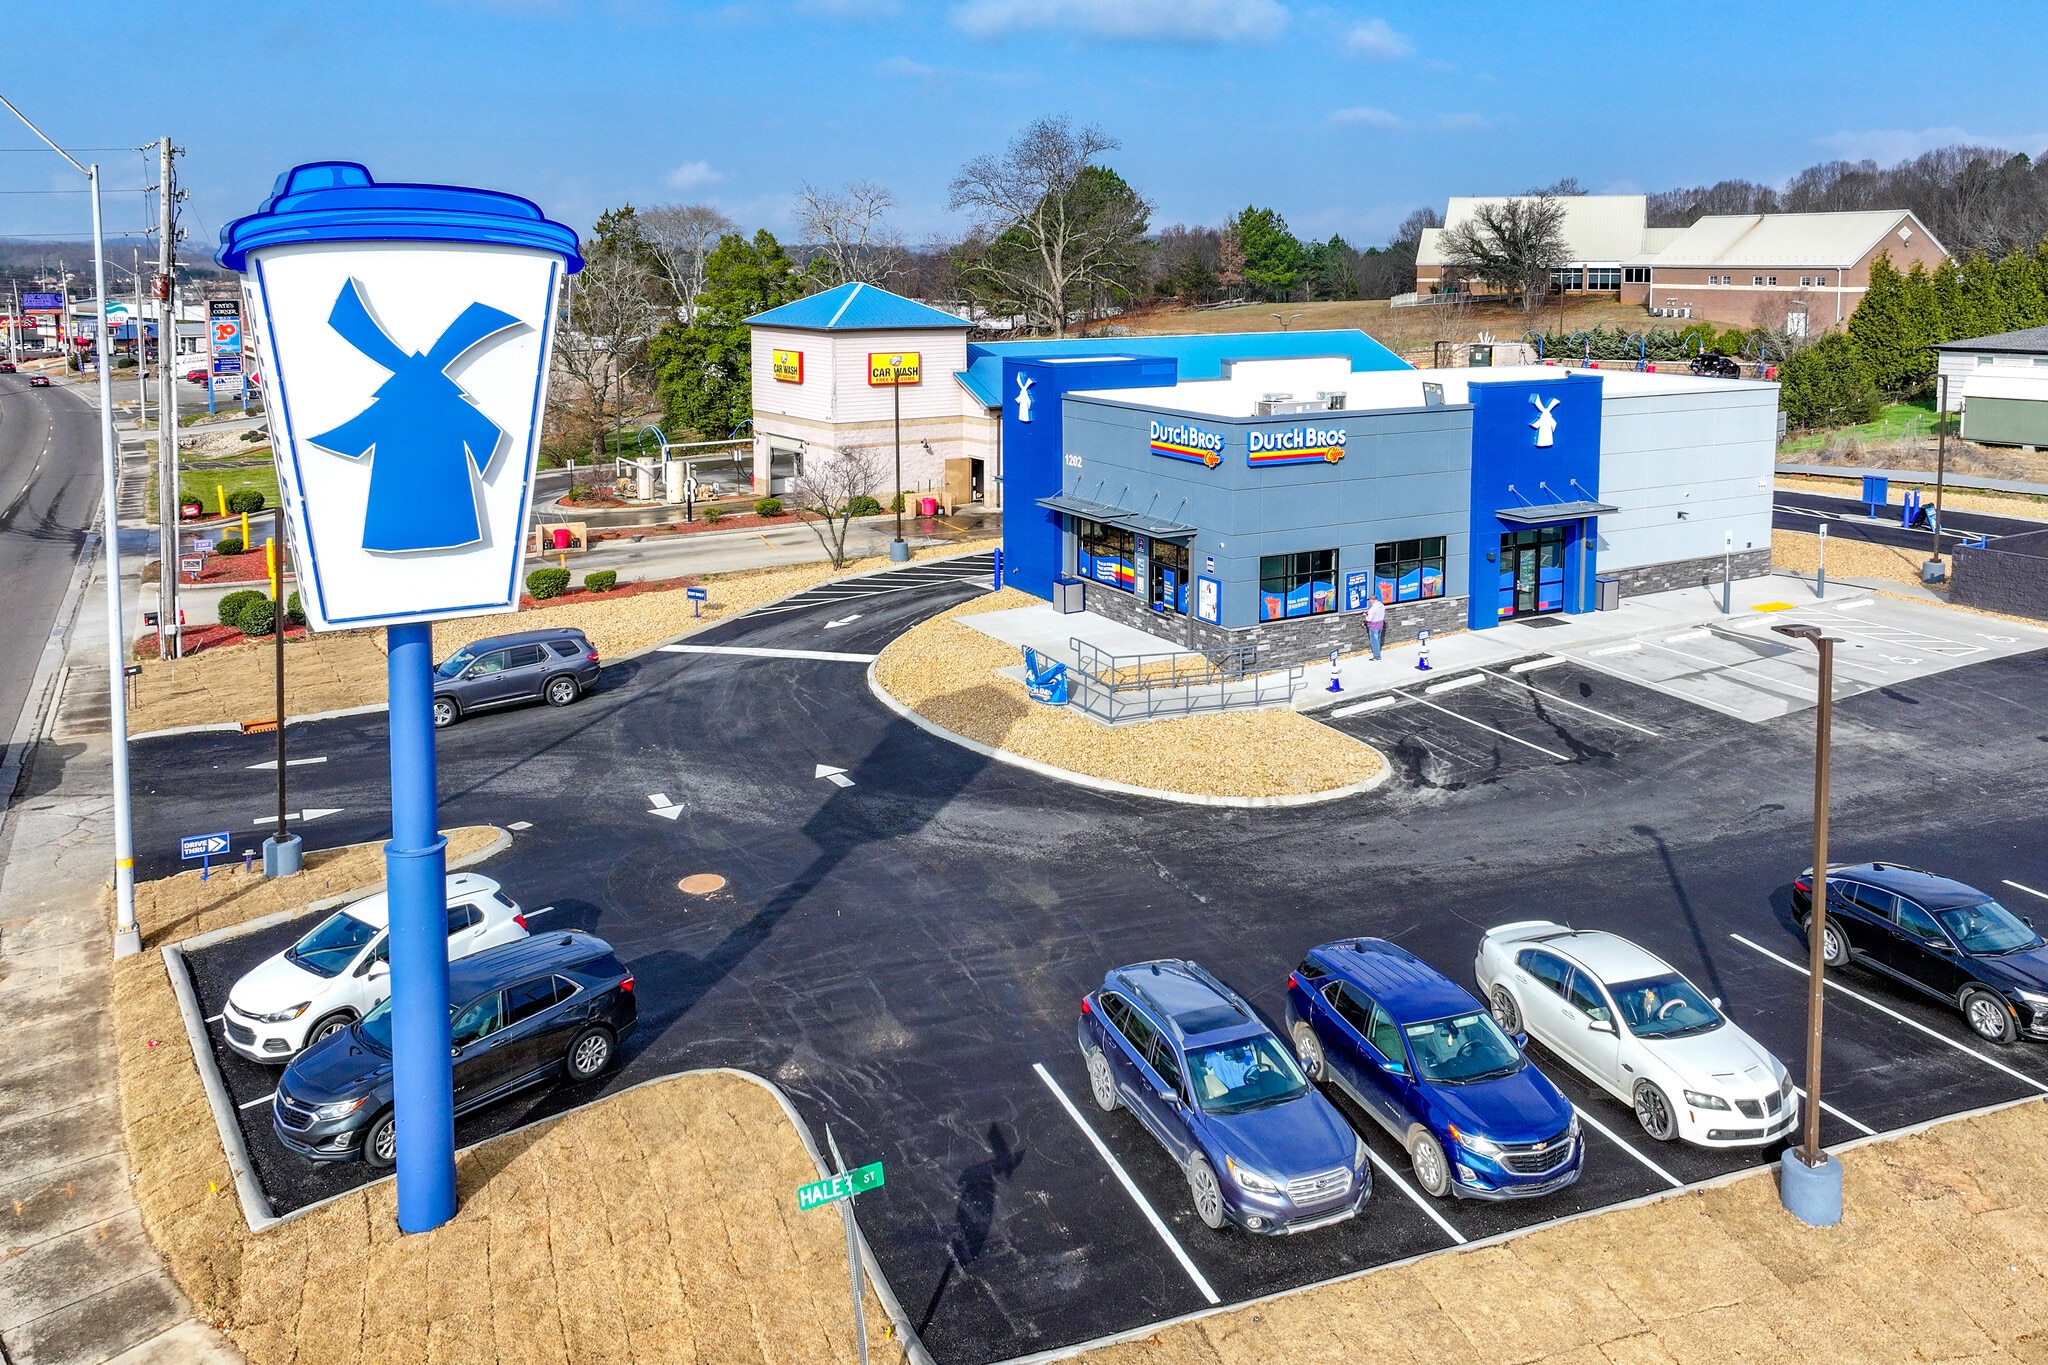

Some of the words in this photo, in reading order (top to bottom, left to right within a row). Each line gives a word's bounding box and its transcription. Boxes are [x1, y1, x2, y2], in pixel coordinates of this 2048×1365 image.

[773, 364, 783, 374] CAR
[783, 365, 798, 376] WASH
[872, 368, 891, 378] CAR
[893, 366, 919, 377] WASH
[1150, 420, 1189, 445] DUTCH
[1189, 427, 1222, 451] BROS
[1249, 427, 1304, 452] DUTCH
[1305, 427, 1346, 447] BROS
[1064, 453, 1083, 468] 1202
[184, 840, 208, 849] DRIVE
[184, 846, 206, 854] THRU
[863, 1171, 875, 1184] ST
